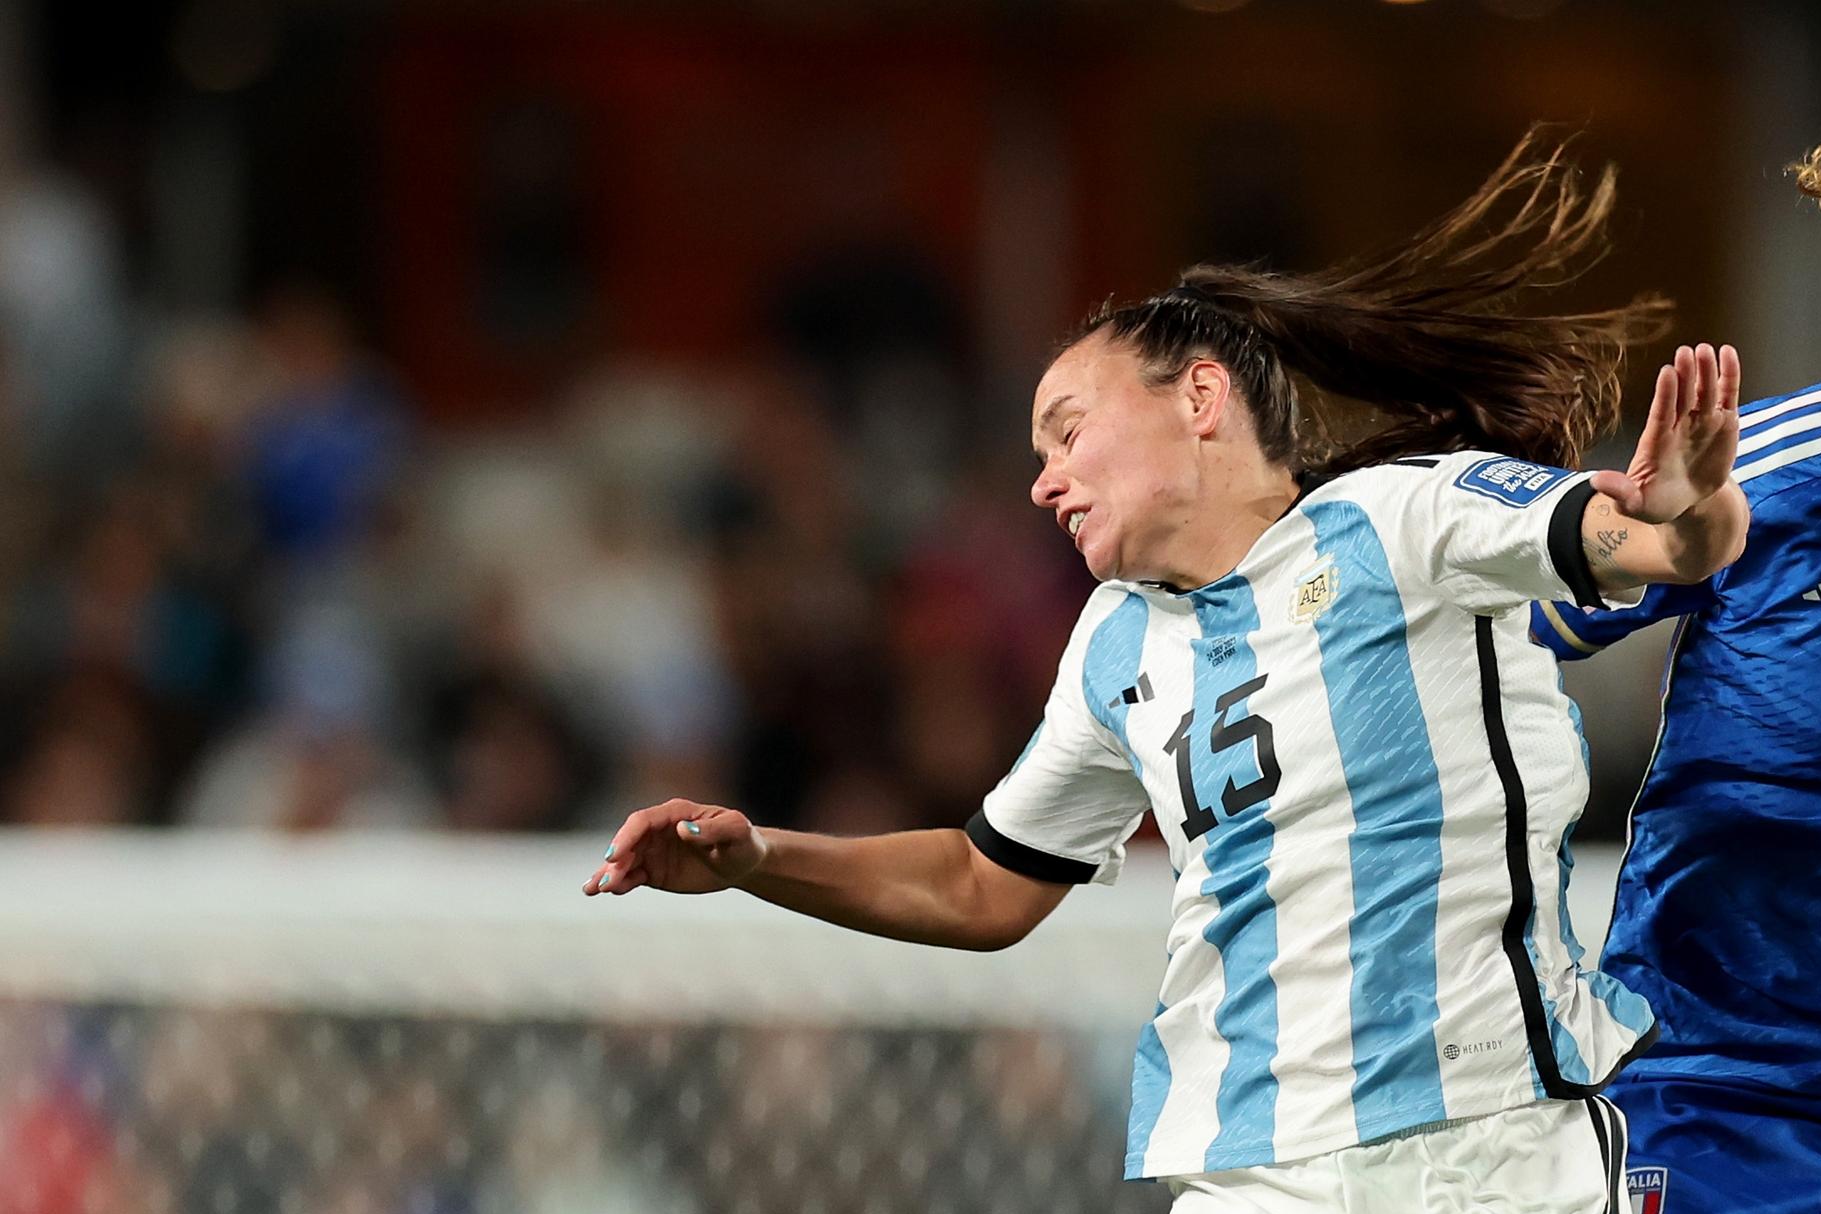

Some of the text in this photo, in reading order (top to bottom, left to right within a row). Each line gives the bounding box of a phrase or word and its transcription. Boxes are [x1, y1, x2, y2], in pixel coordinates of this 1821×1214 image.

[1502, 478, 1522, 493] the
[1299, 573, 1328, 606] AFA
[1162, 673, 1282, 843] 15
[1462, 1040, 1503, 1054] HEAT.RDY
[1626, 1172, 1661, 1189] ALIA
